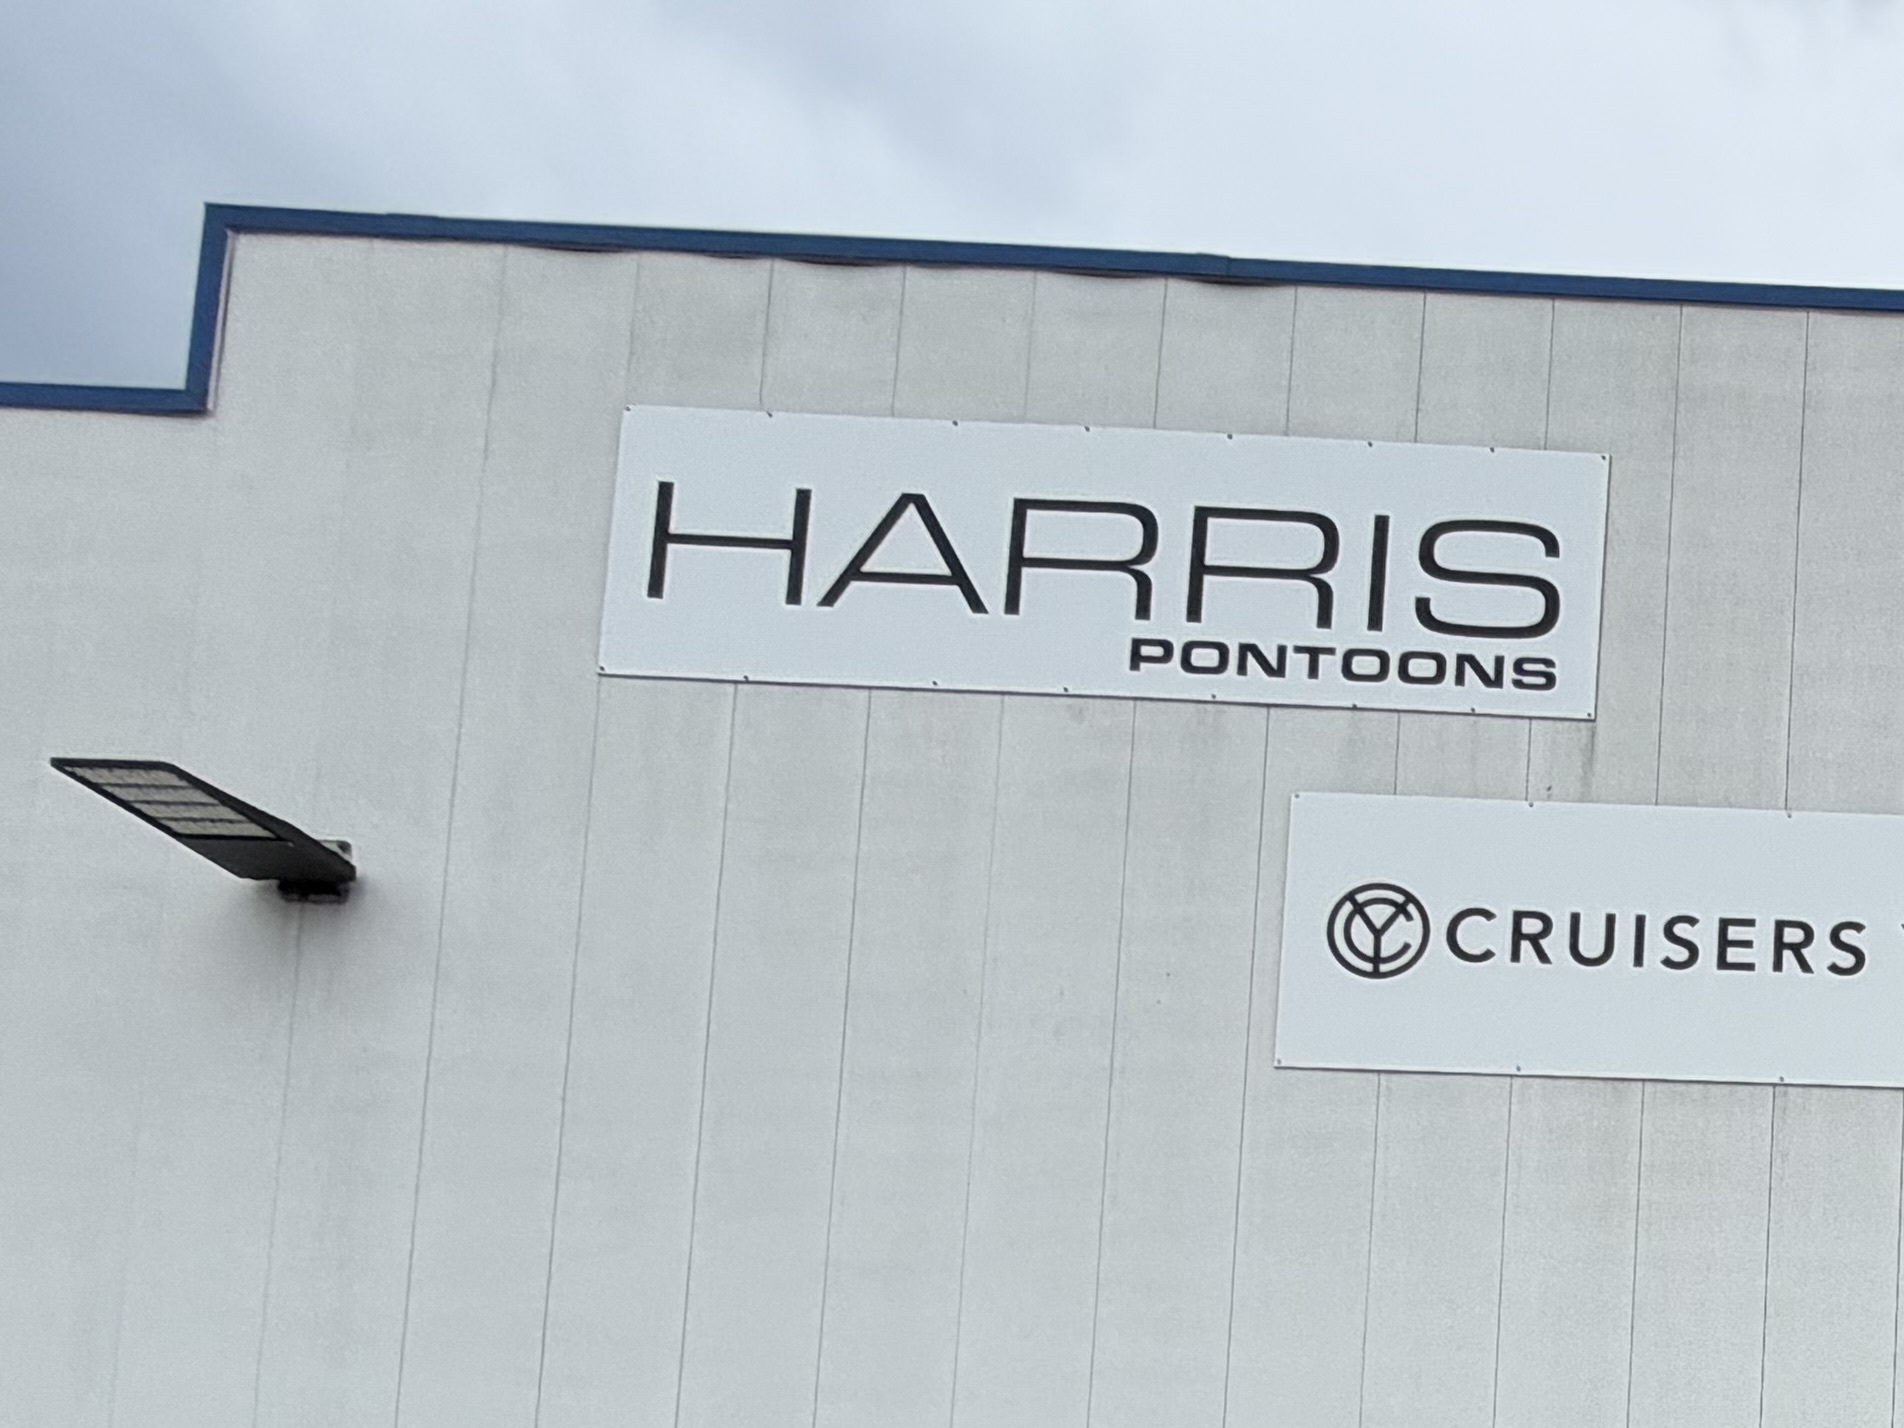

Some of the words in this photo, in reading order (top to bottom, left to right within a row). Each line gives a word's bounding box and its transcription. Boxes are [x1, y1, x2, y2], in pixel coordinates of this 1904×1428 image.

[647, 481, 1560, 639] HARRIS
[1129, 637, 1557, 691] PONTOONS
[1446, 907, 1866, 976] CRUISERS
